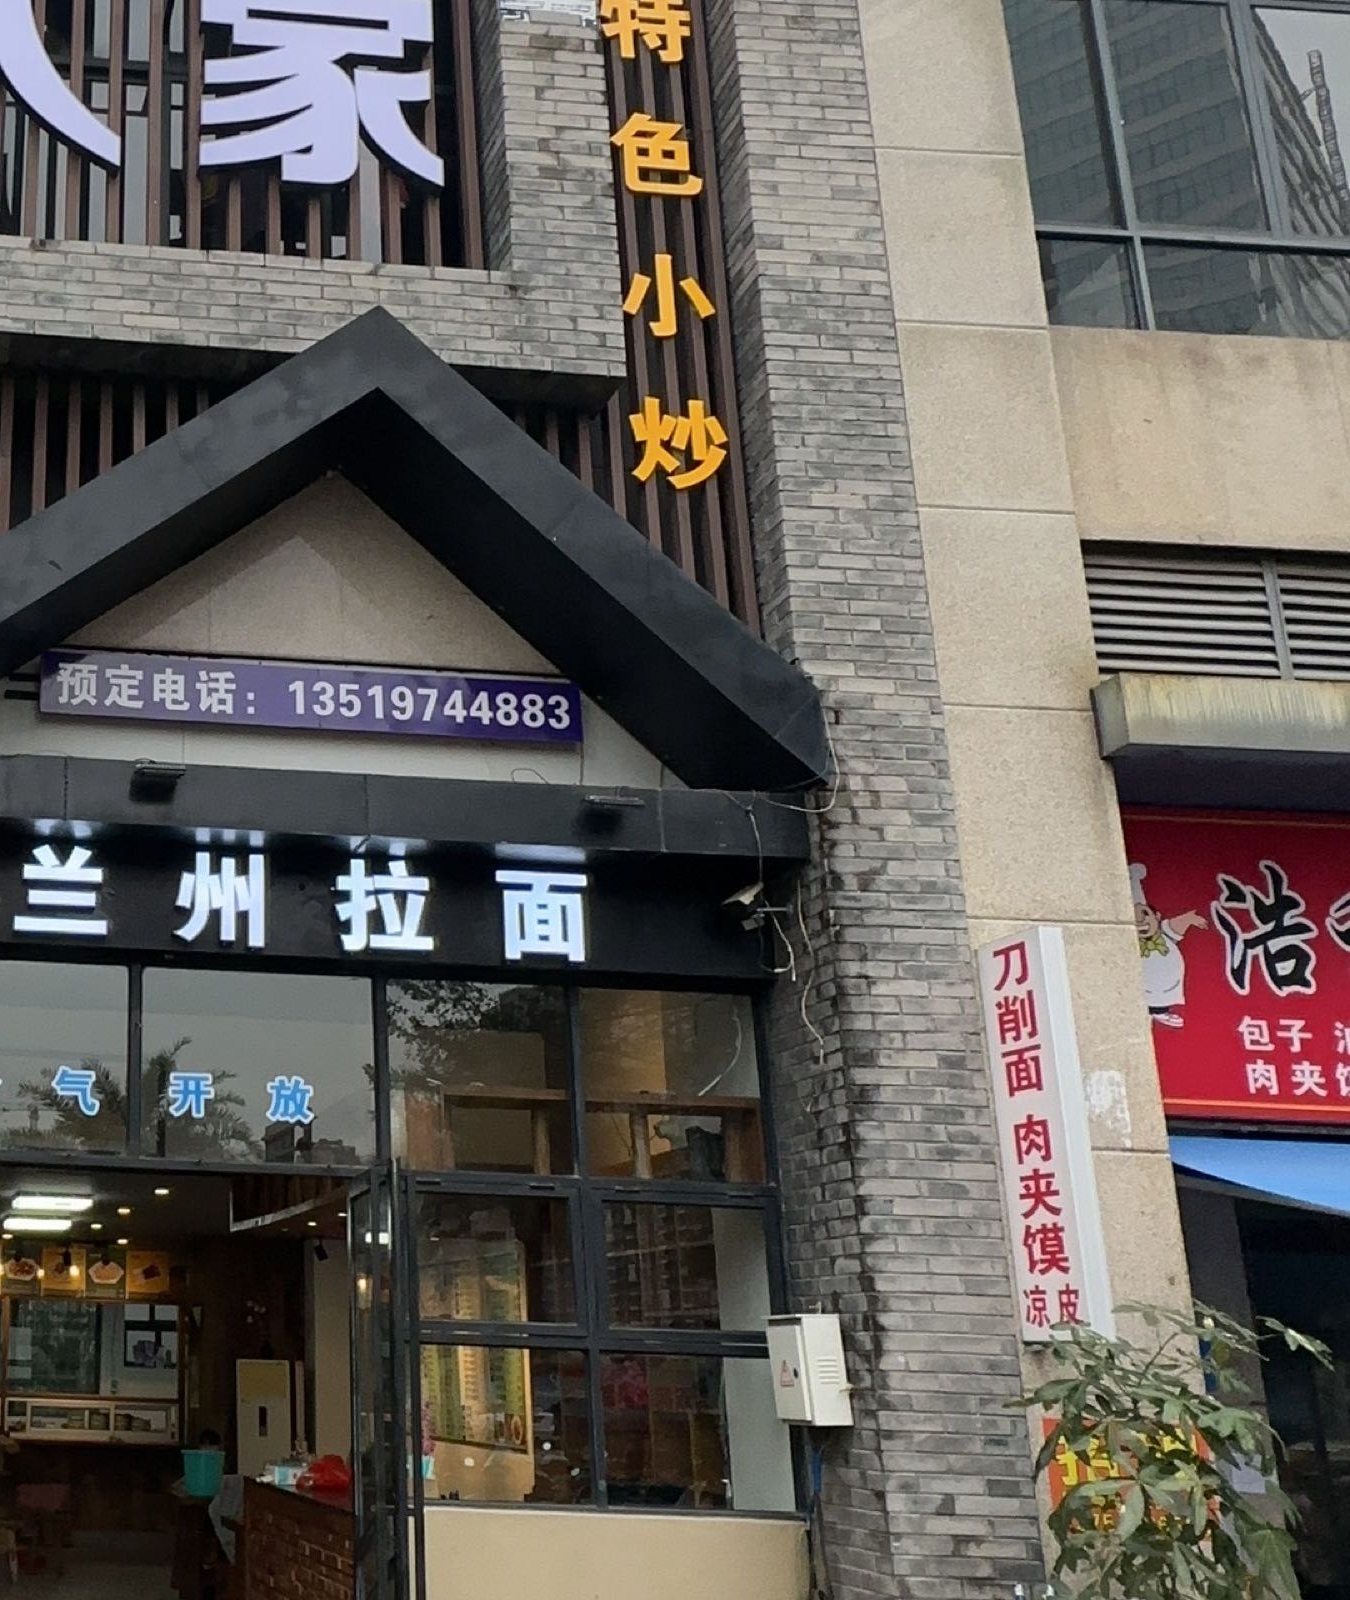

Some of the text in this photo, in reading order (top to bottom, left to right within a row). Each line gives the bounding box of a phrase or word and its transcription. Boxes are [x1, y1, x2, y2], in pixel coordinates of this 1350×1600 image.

[1210, 859, 1350, 997] 浩
[1238, 1015, 1312, 1053] 包子
[1024, 1284, 1081, 1328] 凉皮
